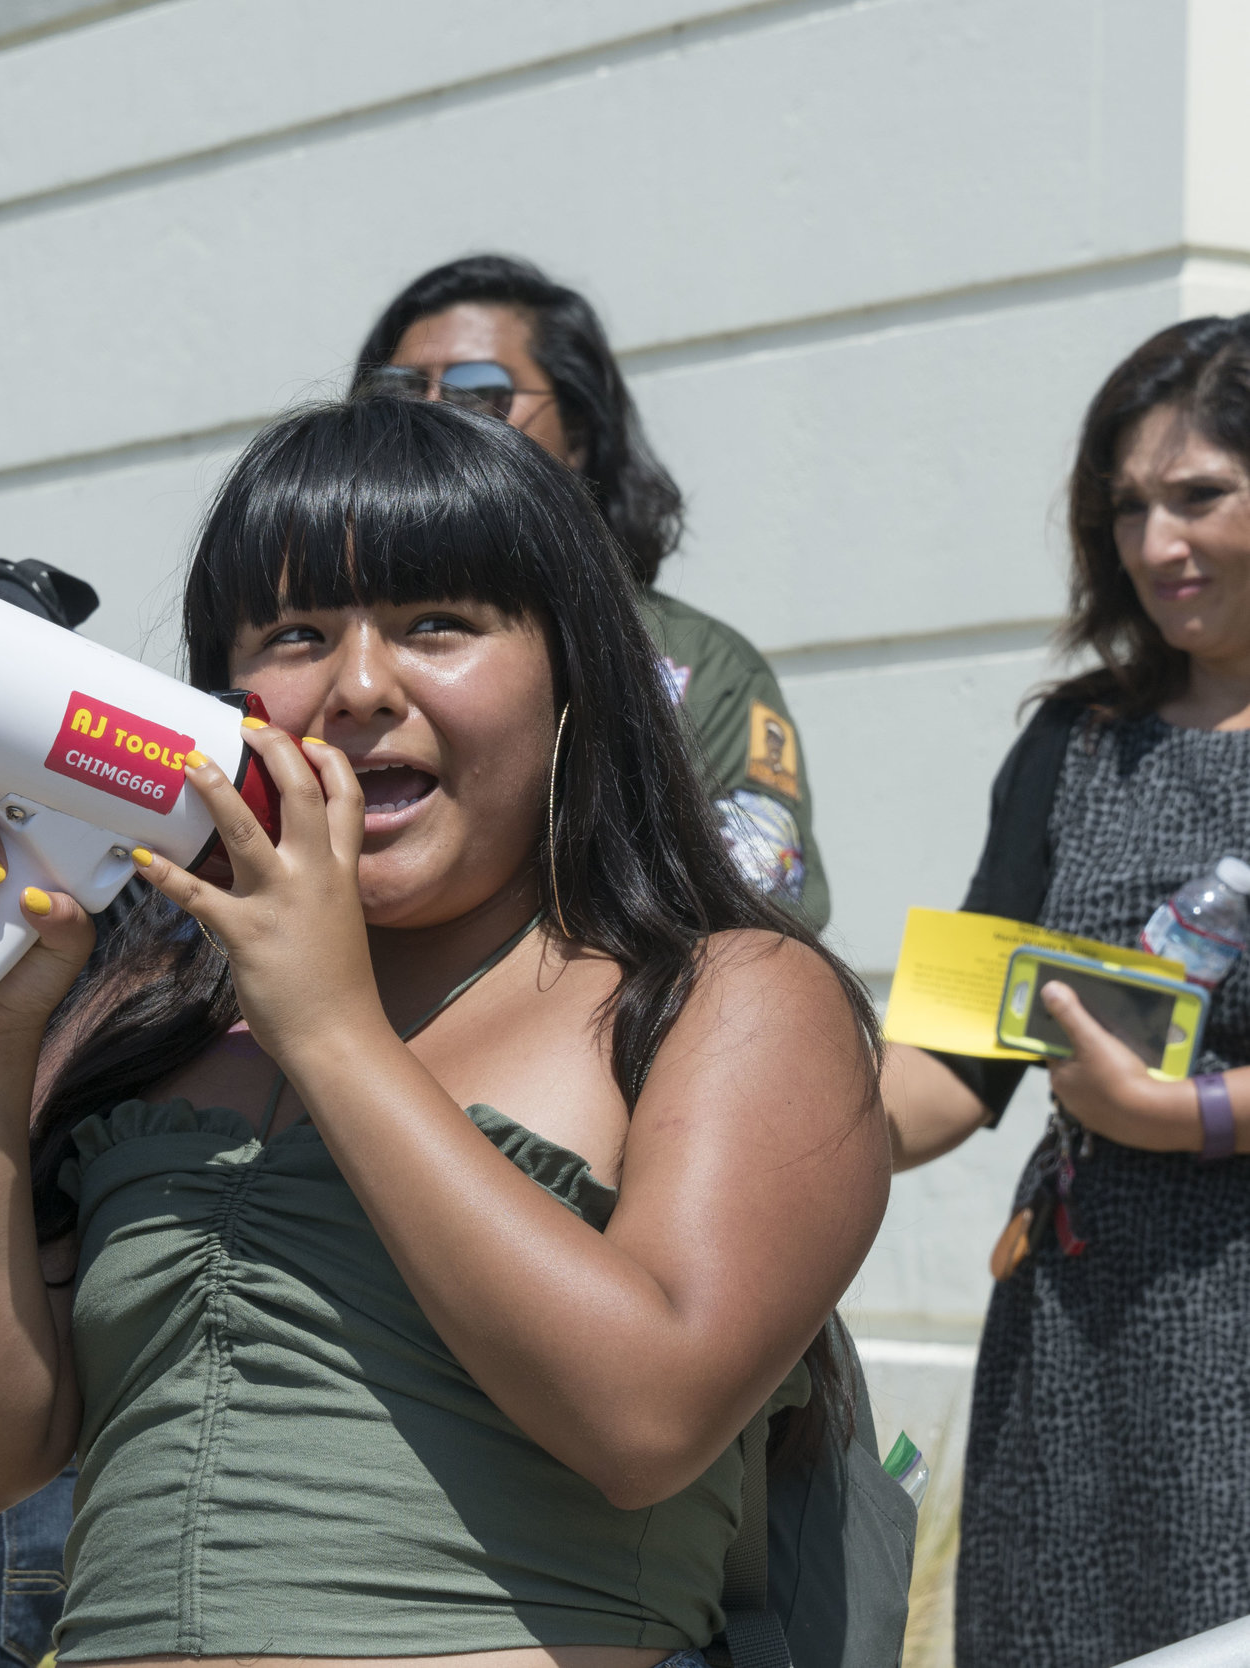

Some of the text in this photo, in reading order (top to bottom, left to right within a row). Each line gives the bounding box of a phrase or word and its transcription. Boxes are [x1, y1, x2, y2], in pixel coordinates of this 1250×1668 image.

[70, 708, 185, 771] AJ TOOLS
[65, 749, 166, 800] CHIMG666
